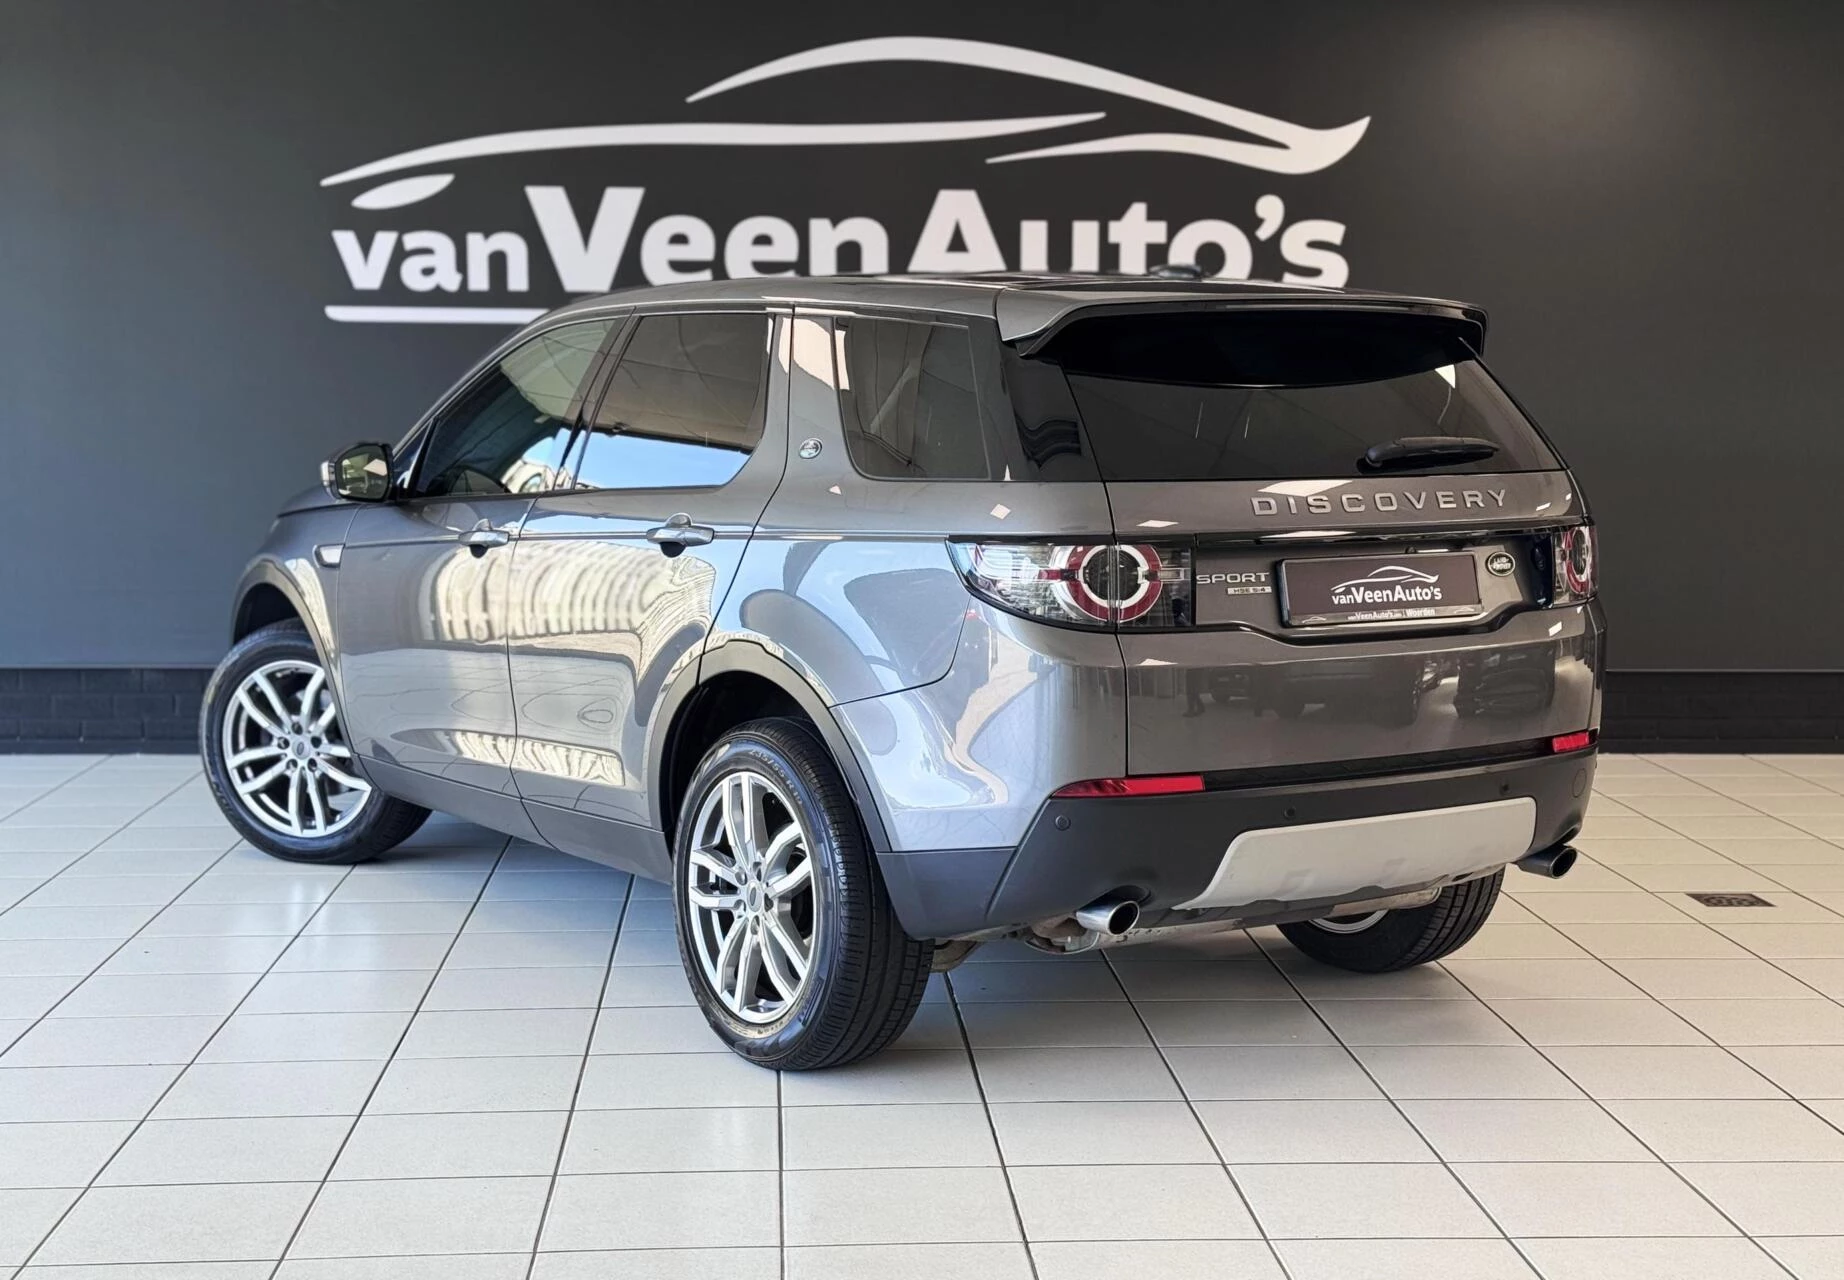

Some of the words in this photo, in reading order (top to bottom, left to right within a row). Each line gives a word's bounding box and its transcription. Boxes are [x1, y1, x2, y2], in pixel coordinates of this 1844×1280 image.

[1250, 488, 1507, 516] DISCOVERY
[1195, 572, 1270, 585] SPORT
[1331, 584, 1442, 606] vanVeenAuto's
